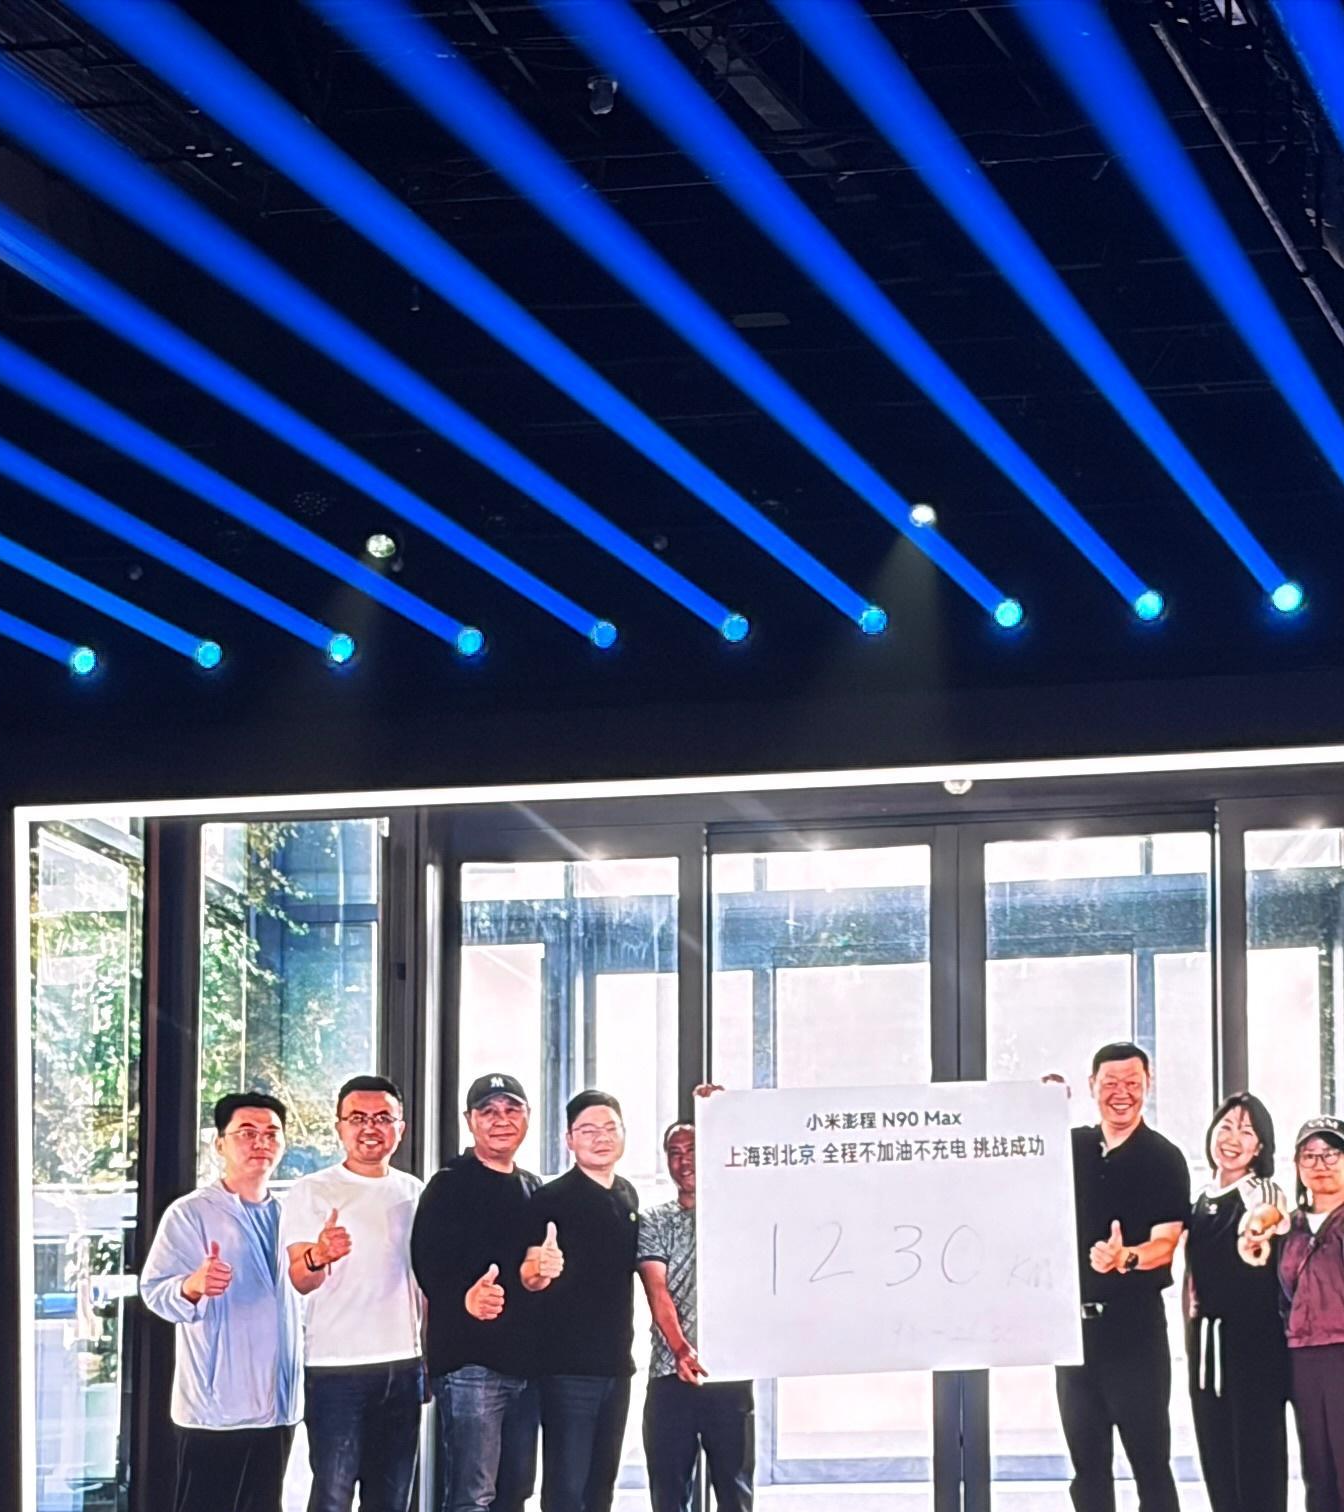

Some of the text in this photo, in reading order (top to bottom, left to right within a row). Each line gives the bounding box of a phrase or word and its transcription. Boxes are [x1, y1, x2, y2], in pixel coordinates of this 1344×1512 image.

[806, 1110, 962, 1131] 小米澎程 N90 Max
[724, 1134, 1045, 1168] 上海到北京 全程不加油不充电 挑战成功
[772, 1221, 985, 1296] 1230
